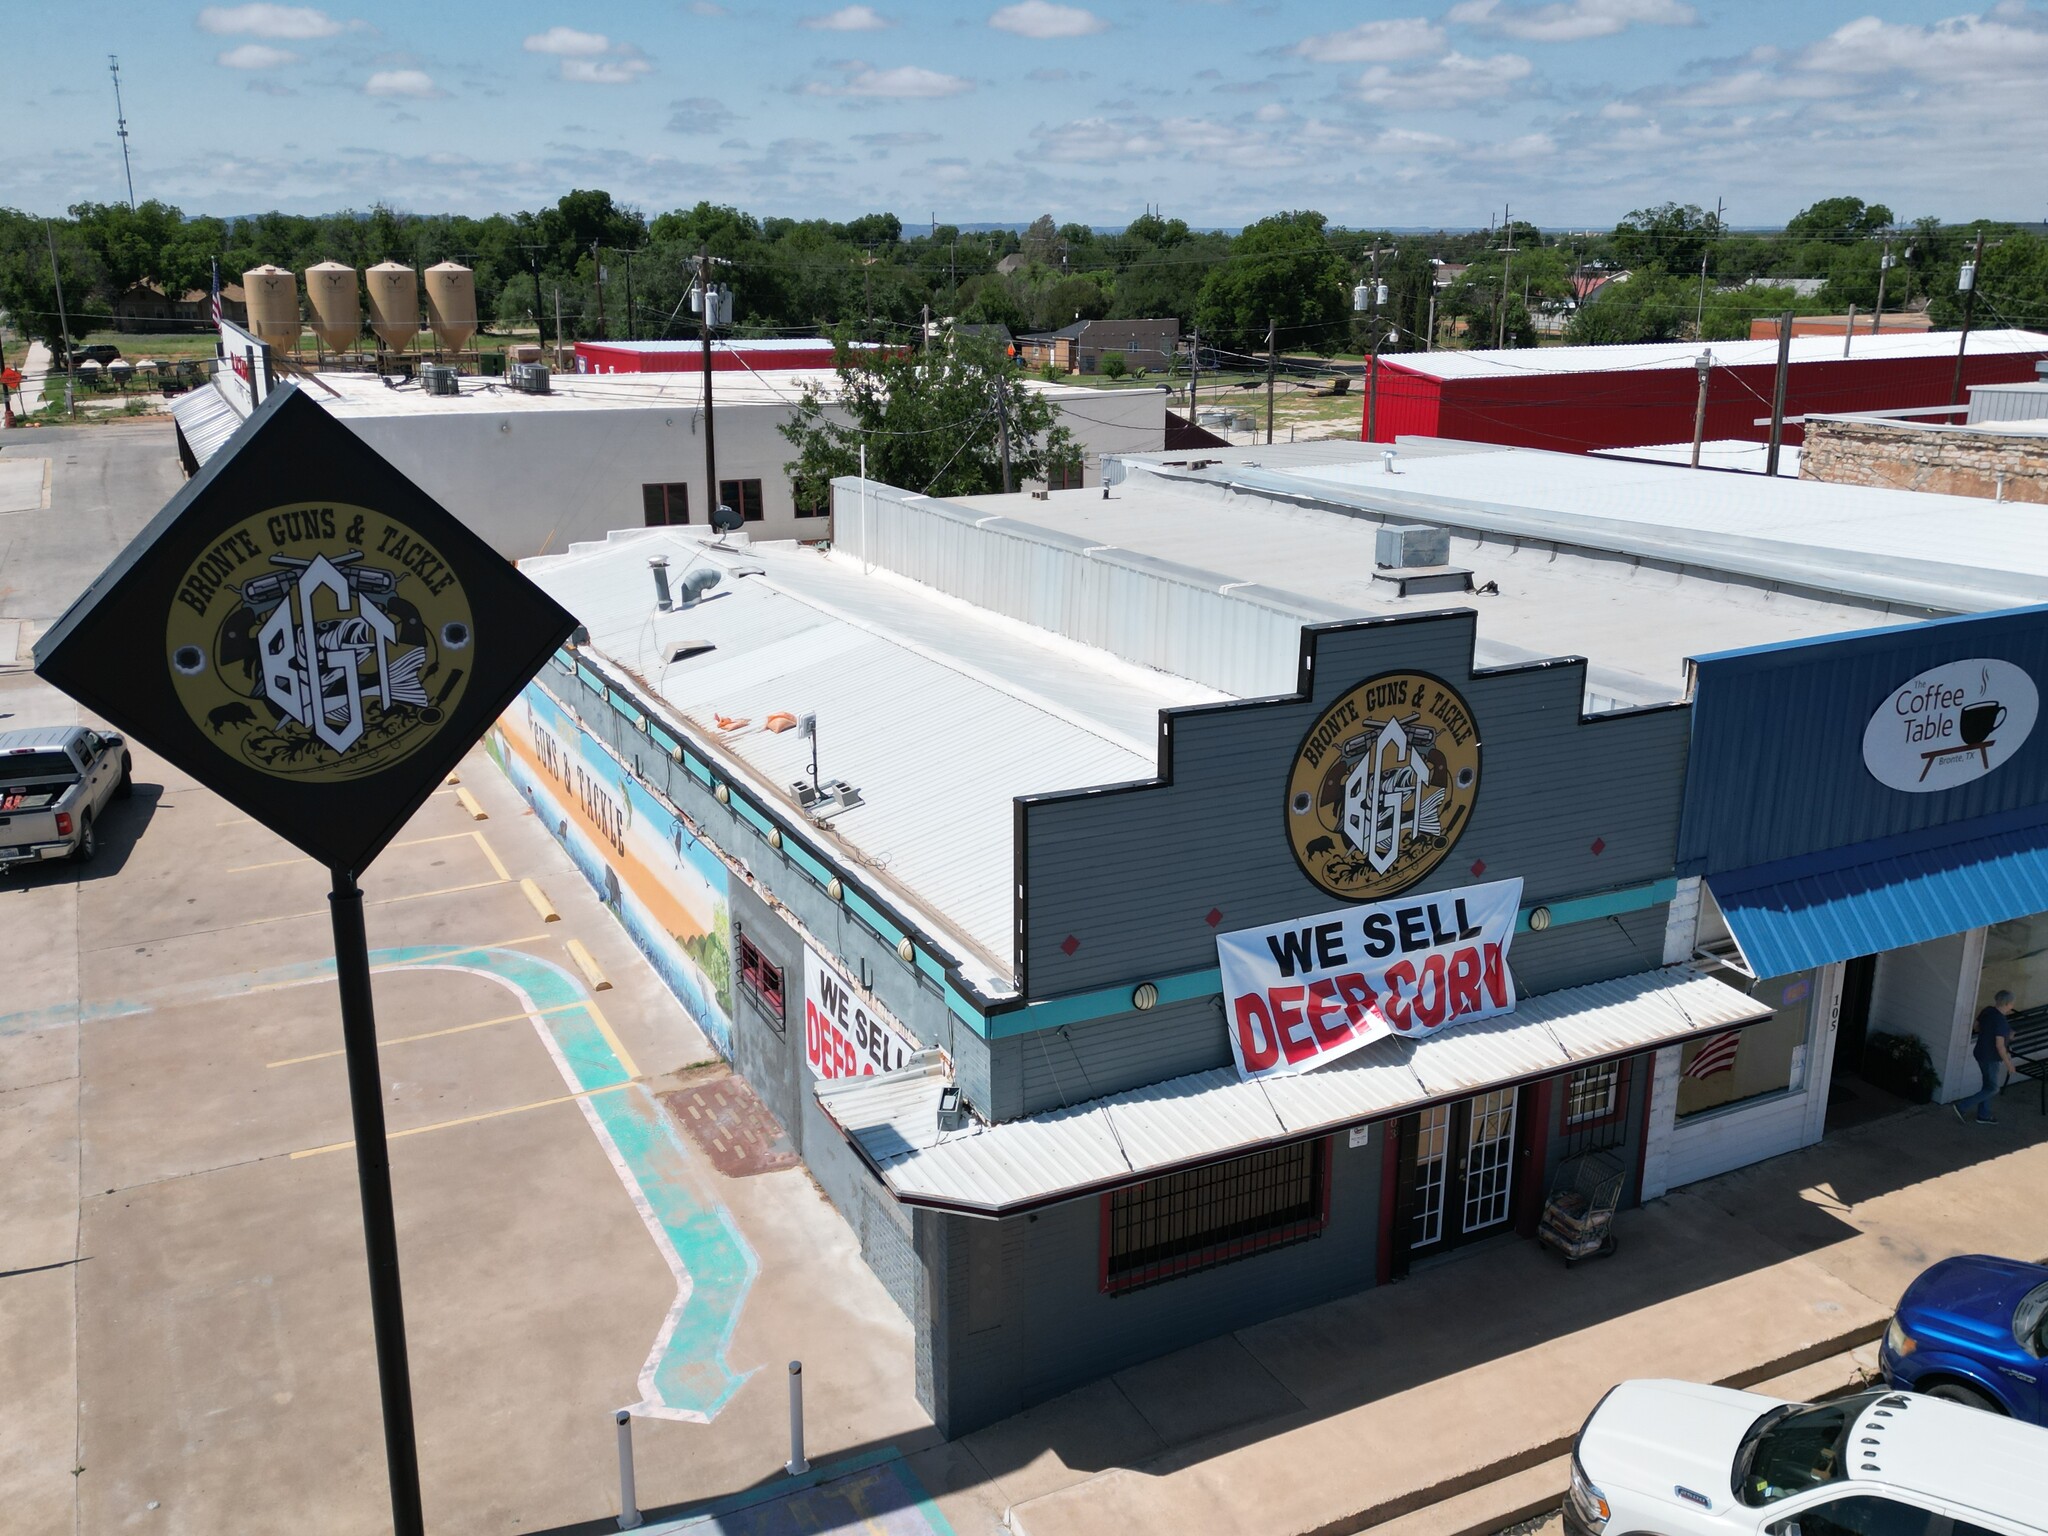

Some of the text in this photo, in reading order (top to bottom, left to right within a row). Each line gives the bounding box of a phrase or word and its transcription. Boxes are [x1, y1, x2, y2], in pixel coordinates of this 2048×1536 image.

[178, 508, 456, 617] BRONTE GUNS & TACKLE
[1303, 680, 1474, 769] BRONTE GUNS & TACKLE
[1896, 684, 1965, 716] Coffee
[1914, 680, 1927, 689] The
[1903, 713, 1953, 744] Table
[534, 721, 625, 858] GUNS & TACKLE
[1266, 898, 1482, 978] WE SELL
[821, 969, 903, 1072] WE SELL
[1234, 943, 1508, 1073] DEER CORN
[1830, 994, 1839, 1031] 105
